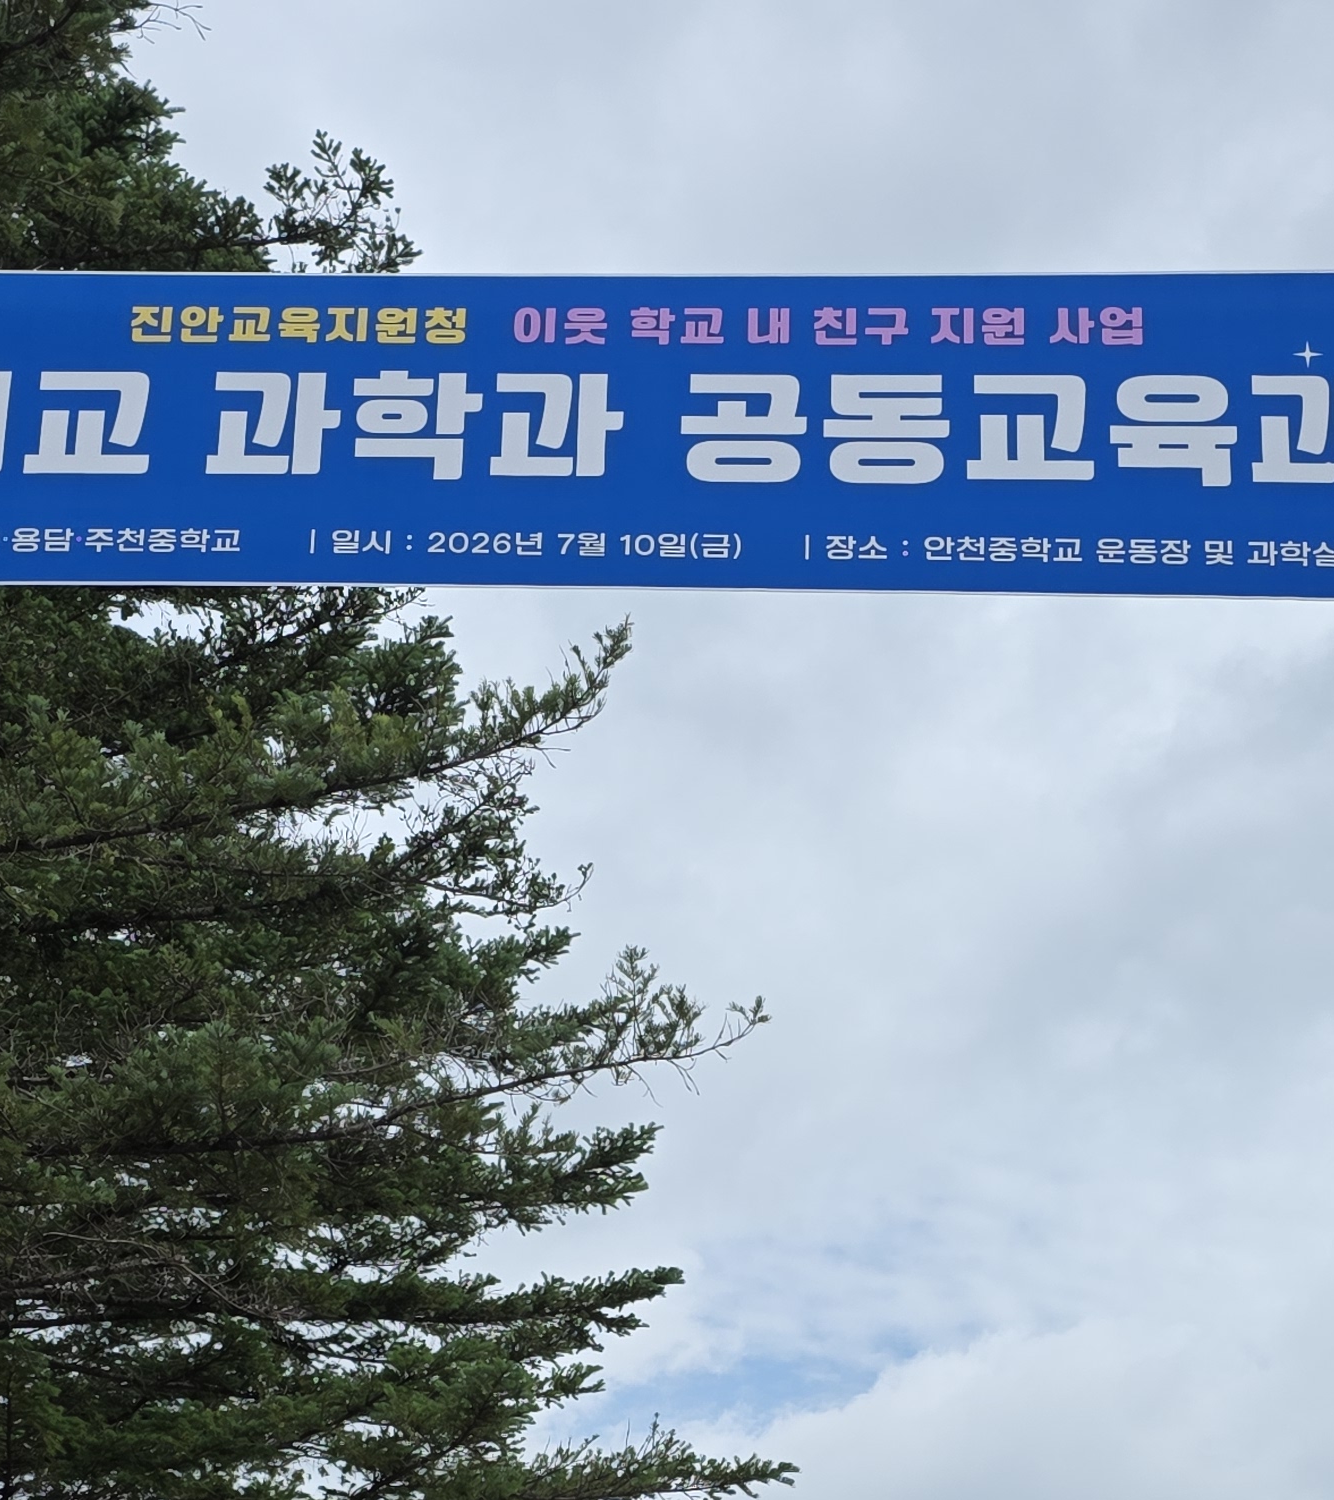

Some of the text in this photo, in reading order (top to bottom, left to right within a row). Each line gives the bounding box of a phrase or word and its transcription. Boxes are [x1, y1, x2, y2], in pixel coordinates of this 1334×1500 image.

[130, 305, 1144, 346] 진안교육지원청 이웃 학교 내 친구 지원 사업
[205, 370, 625, 481] 과학과
[331, 529, 392, 555] 일시
[427, 531, 543, 556] 2026년
[557, 532, 606, 557] 7월
[619, 532, 742, 560] 10일(금)
[825, 535, 888, 560] 장소
[923, 535, 1083, 563] 안천중학교
[1095, 538, 1192, 565] 운동장
[1204, 540, 1234, 566] 및
